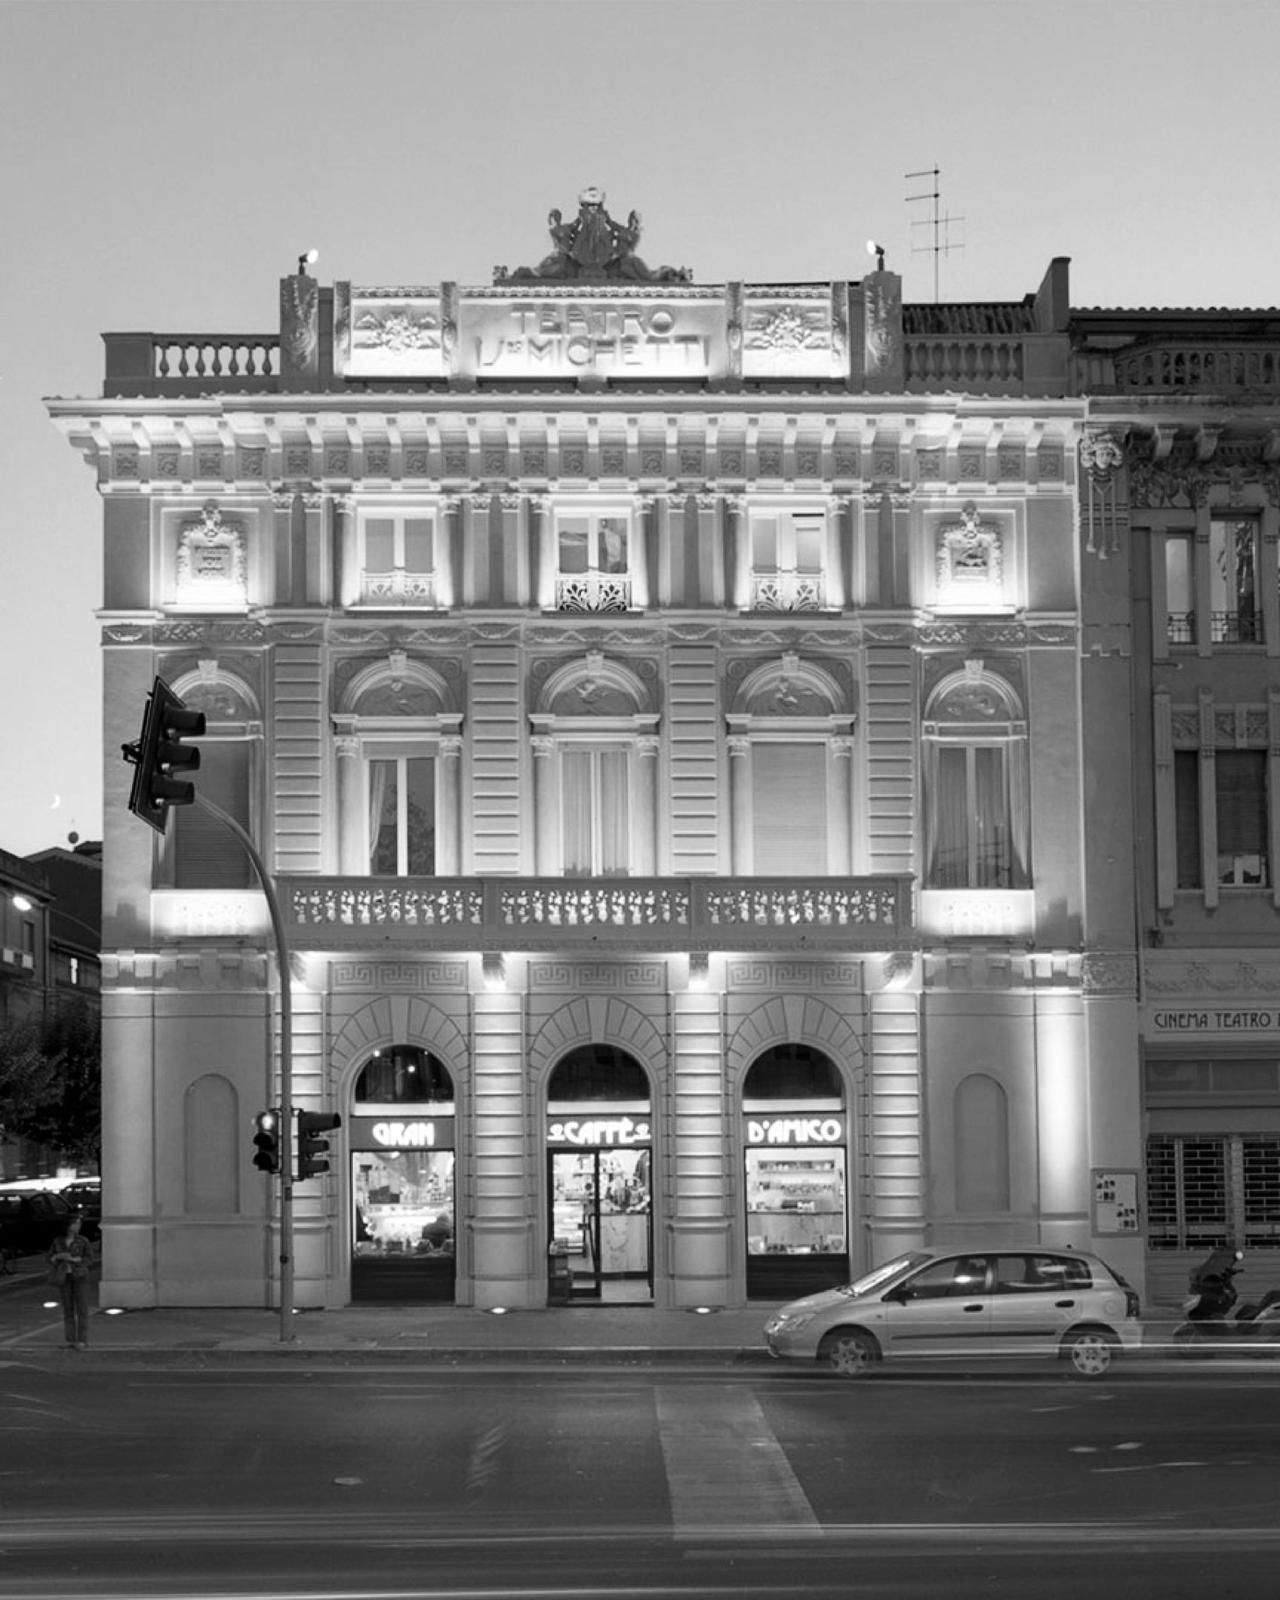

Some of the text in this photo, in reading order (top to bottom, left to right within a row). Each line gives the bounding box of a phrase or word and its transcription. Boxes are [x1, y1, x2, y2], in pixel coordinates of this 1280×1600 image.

[510, 303, 674, 336] TEATRO
[527, 333, 710, 367] MICHETTI
[1154, 1012, 1208, 1028] CINEMA
[1215, 1011, 1271, 1028] TEATRO
[372, 1122, 435, 1146] GRAN
[747, 1118, 842, 1143] D'AMICO
